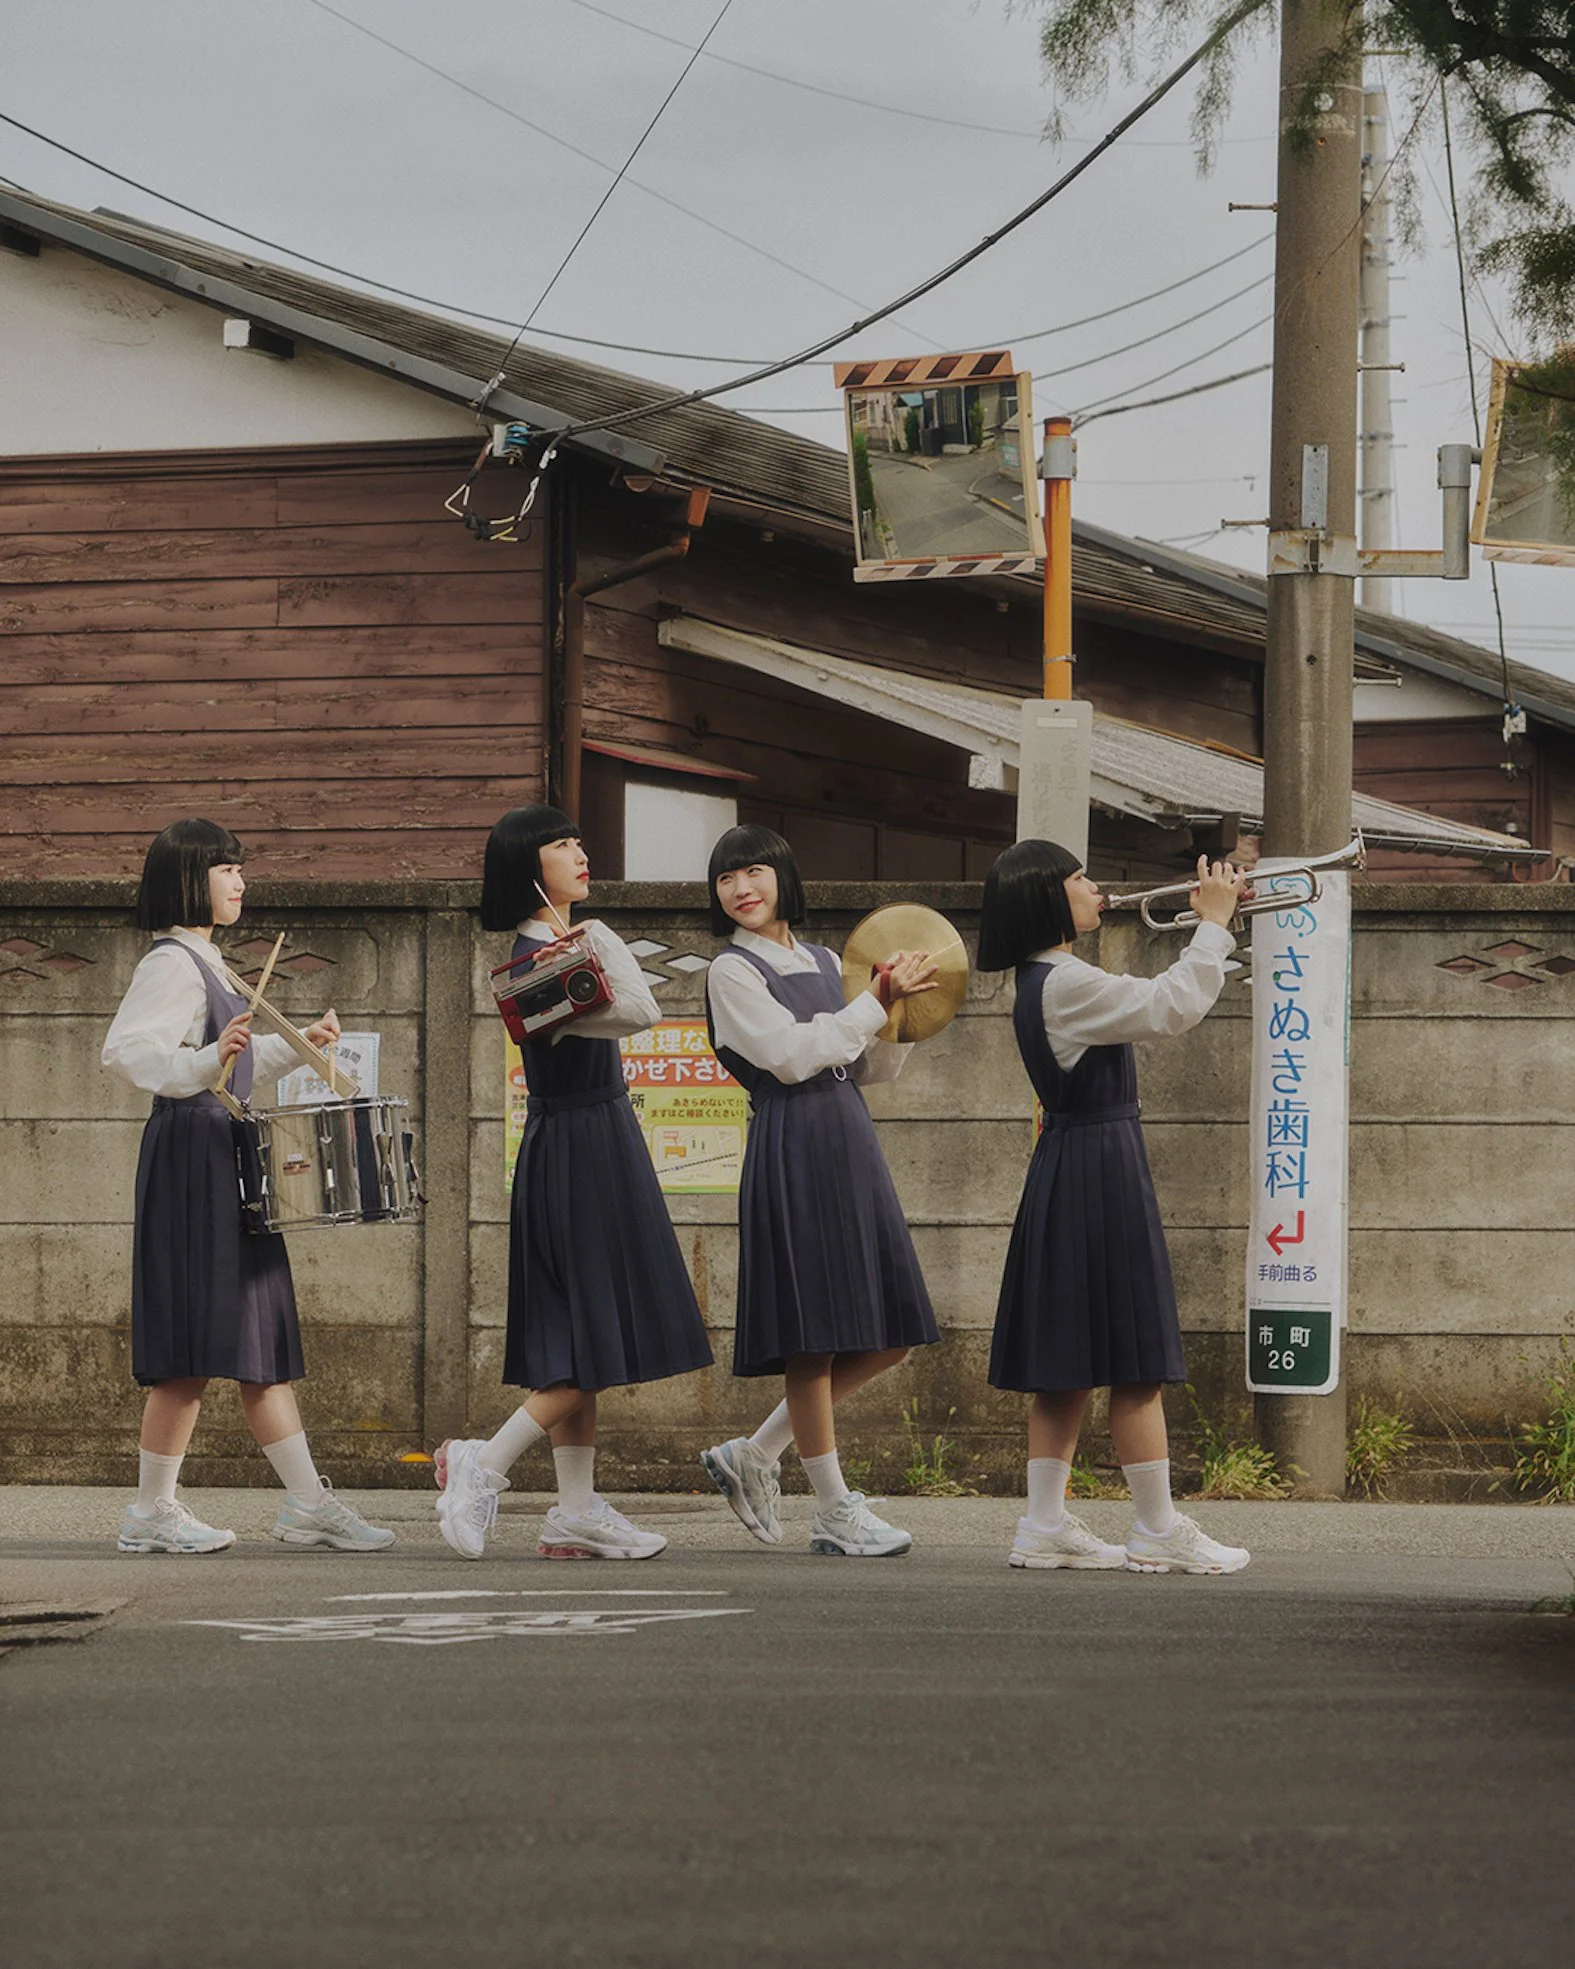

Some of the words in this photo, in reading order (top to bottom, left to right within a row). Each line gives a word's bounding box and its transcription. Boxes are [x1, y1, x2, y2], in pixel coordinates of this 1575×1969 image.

[1265, 946, 1310, 1199] さぬき歯科
[1258, 1264, 1317, 1282] 手前曲る
[1267, 1349, 1296, 1371] 26
